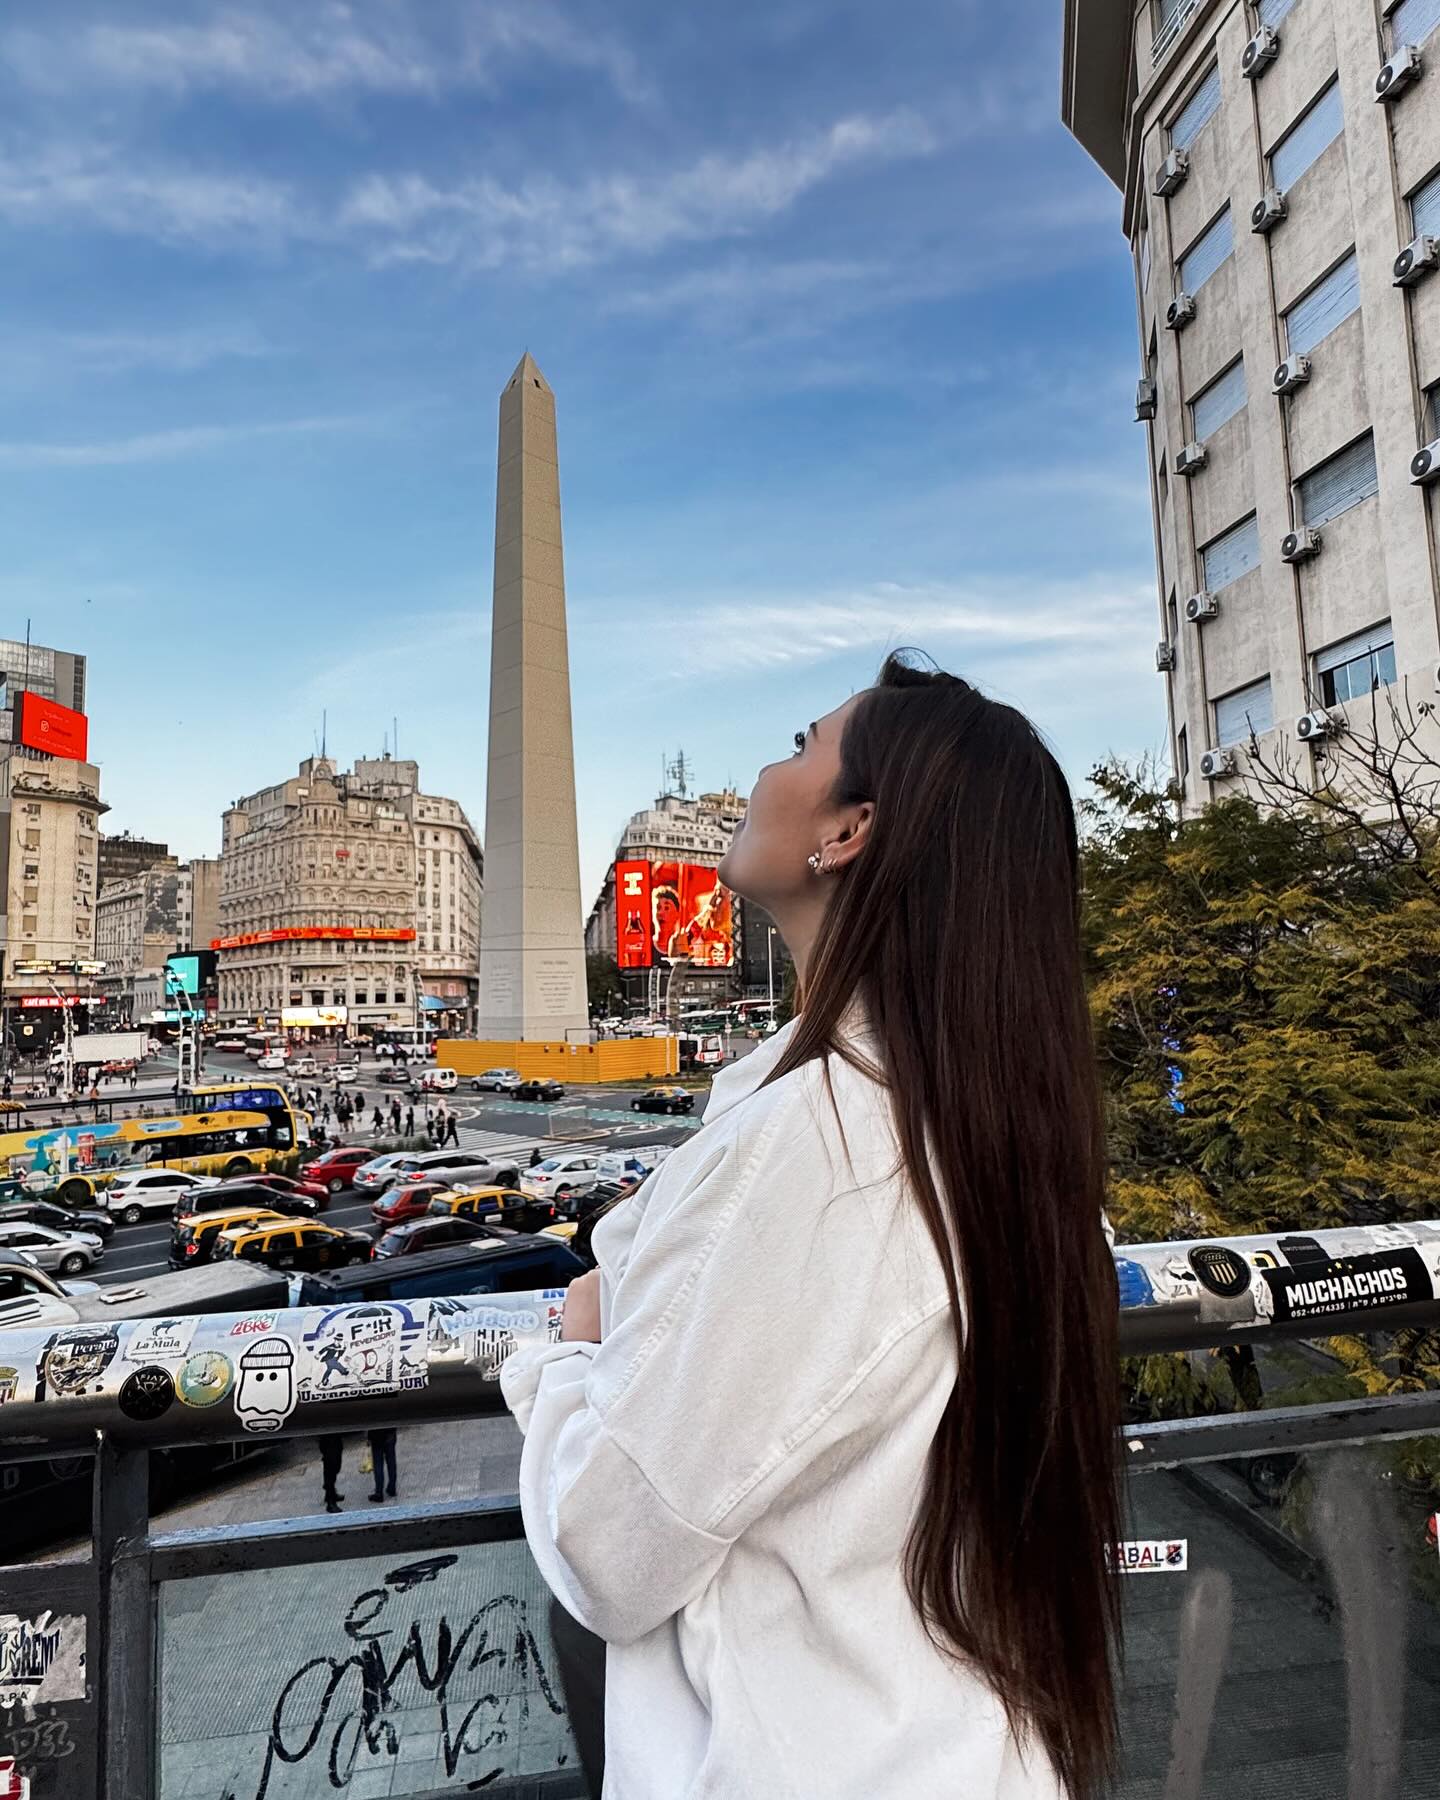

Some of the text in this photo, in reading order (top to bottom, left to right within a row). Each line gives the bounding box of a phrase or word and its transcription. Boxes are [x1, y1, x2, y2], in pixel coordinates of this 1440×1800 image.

[1285, 1266, 1408, 1308] MUCHACHOS
[1291, 1302, 1346, 1318] 052-4474335
[140, 1373, 165, 1383] FIAT
